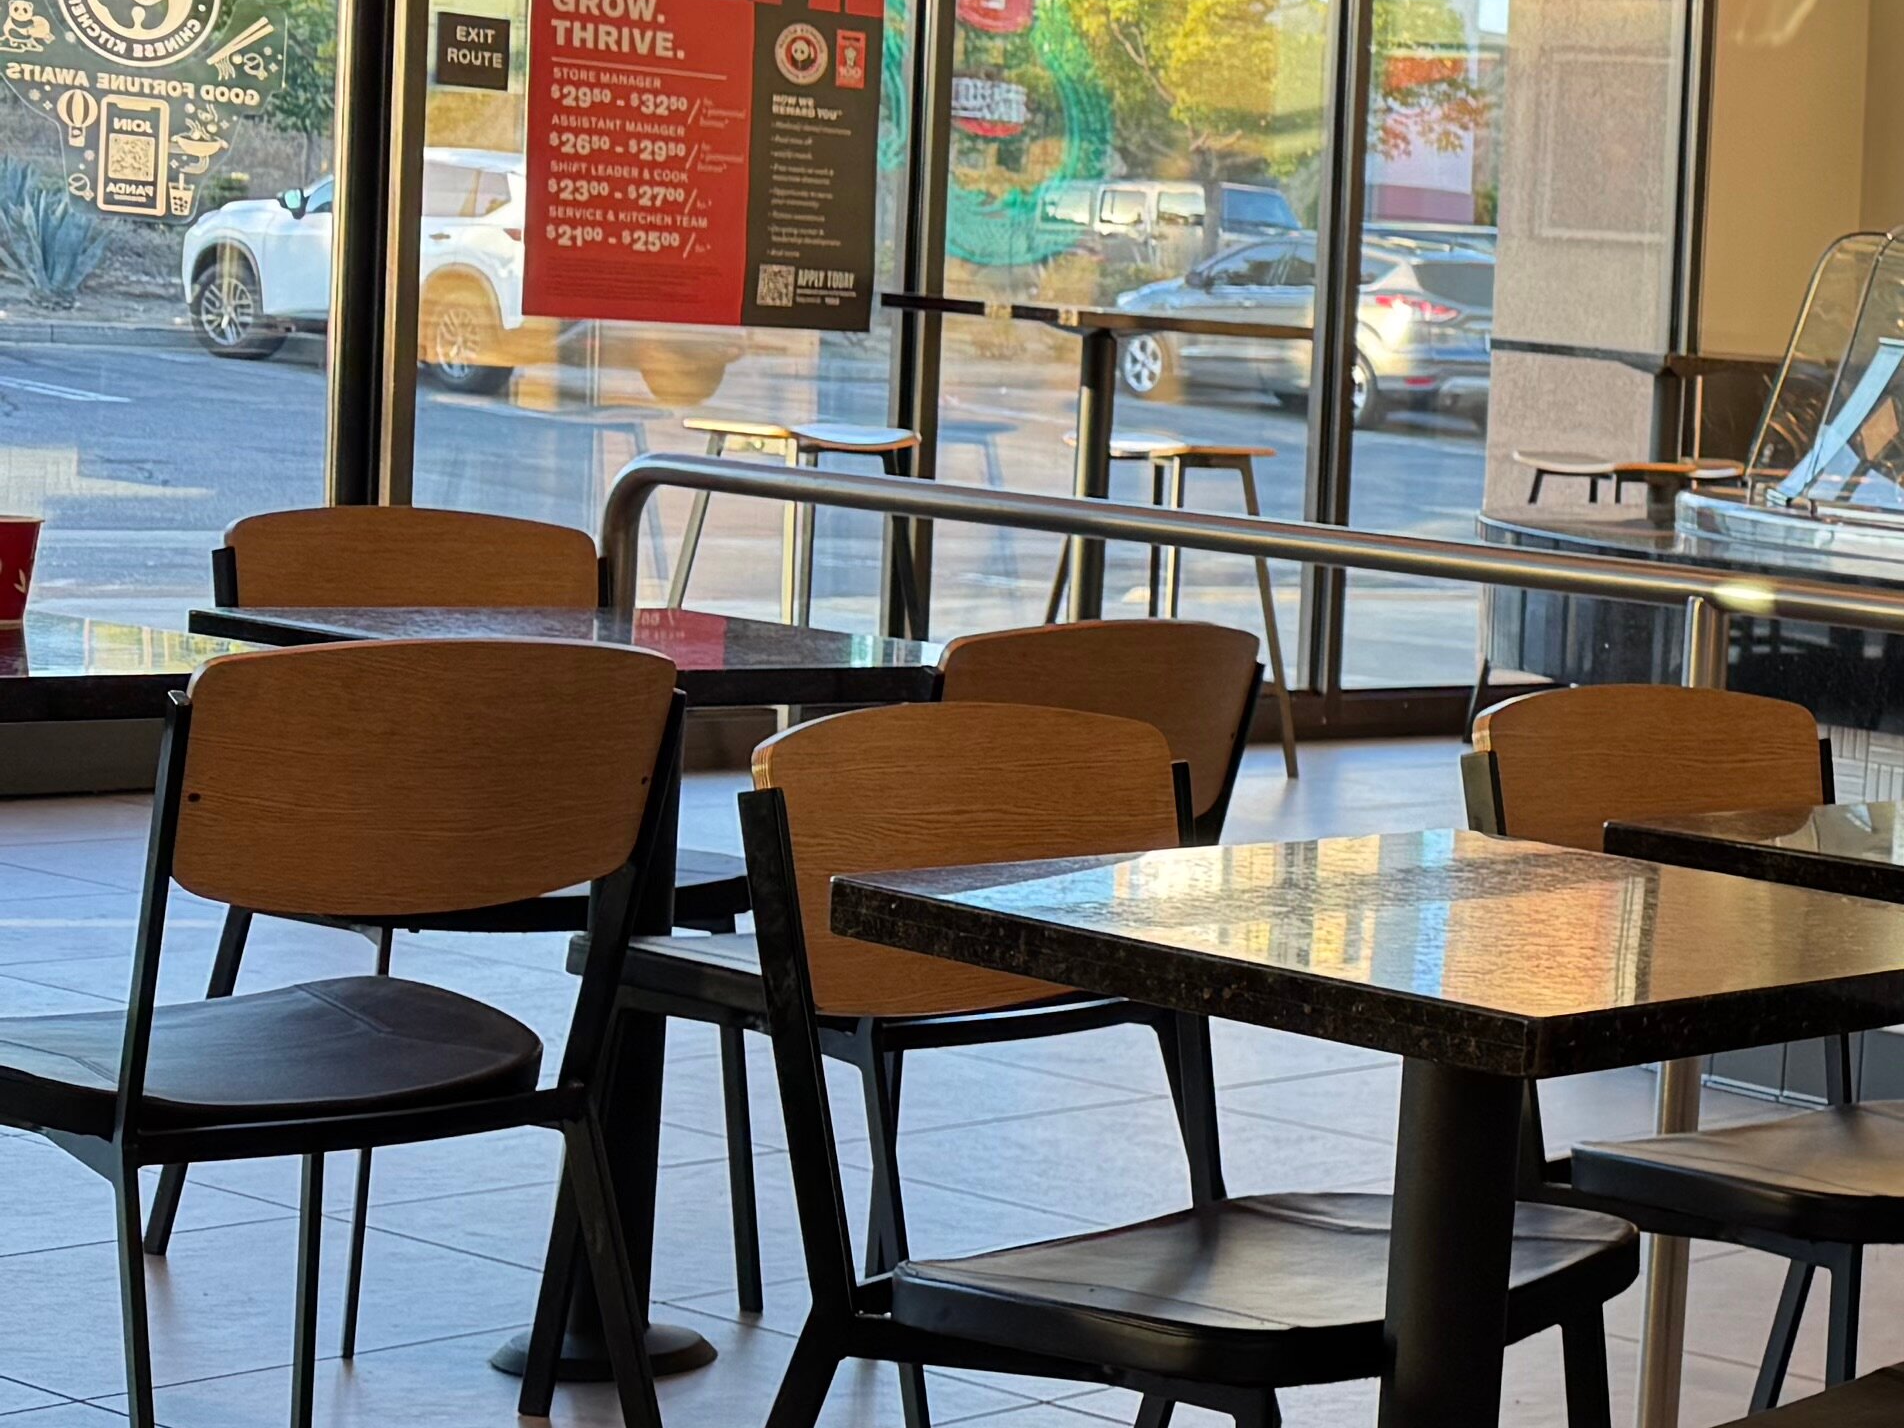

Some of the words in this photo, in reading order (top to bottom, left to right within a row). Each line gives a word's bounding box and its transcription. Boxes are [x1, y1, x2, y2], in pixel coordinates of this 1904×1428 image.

[456, 25, 496, 44] EXIT
[551, 18, 685, 60] THRIVE.
[447, 47, 502, 68] ROUTE
[553, 66, 596, 83] STORE
[599, 71, 662, 89] MANAGER
[551, 114, 622, 131] ASSISTANT
[625, 120, 686, 137] MANAGER
[618, 211, 672, 226] KITCHEN
[676, 212, 708, 229] TEAM
[797, 268, 825, 288] APPLY
[827, 270, 855, 289] TODAY
